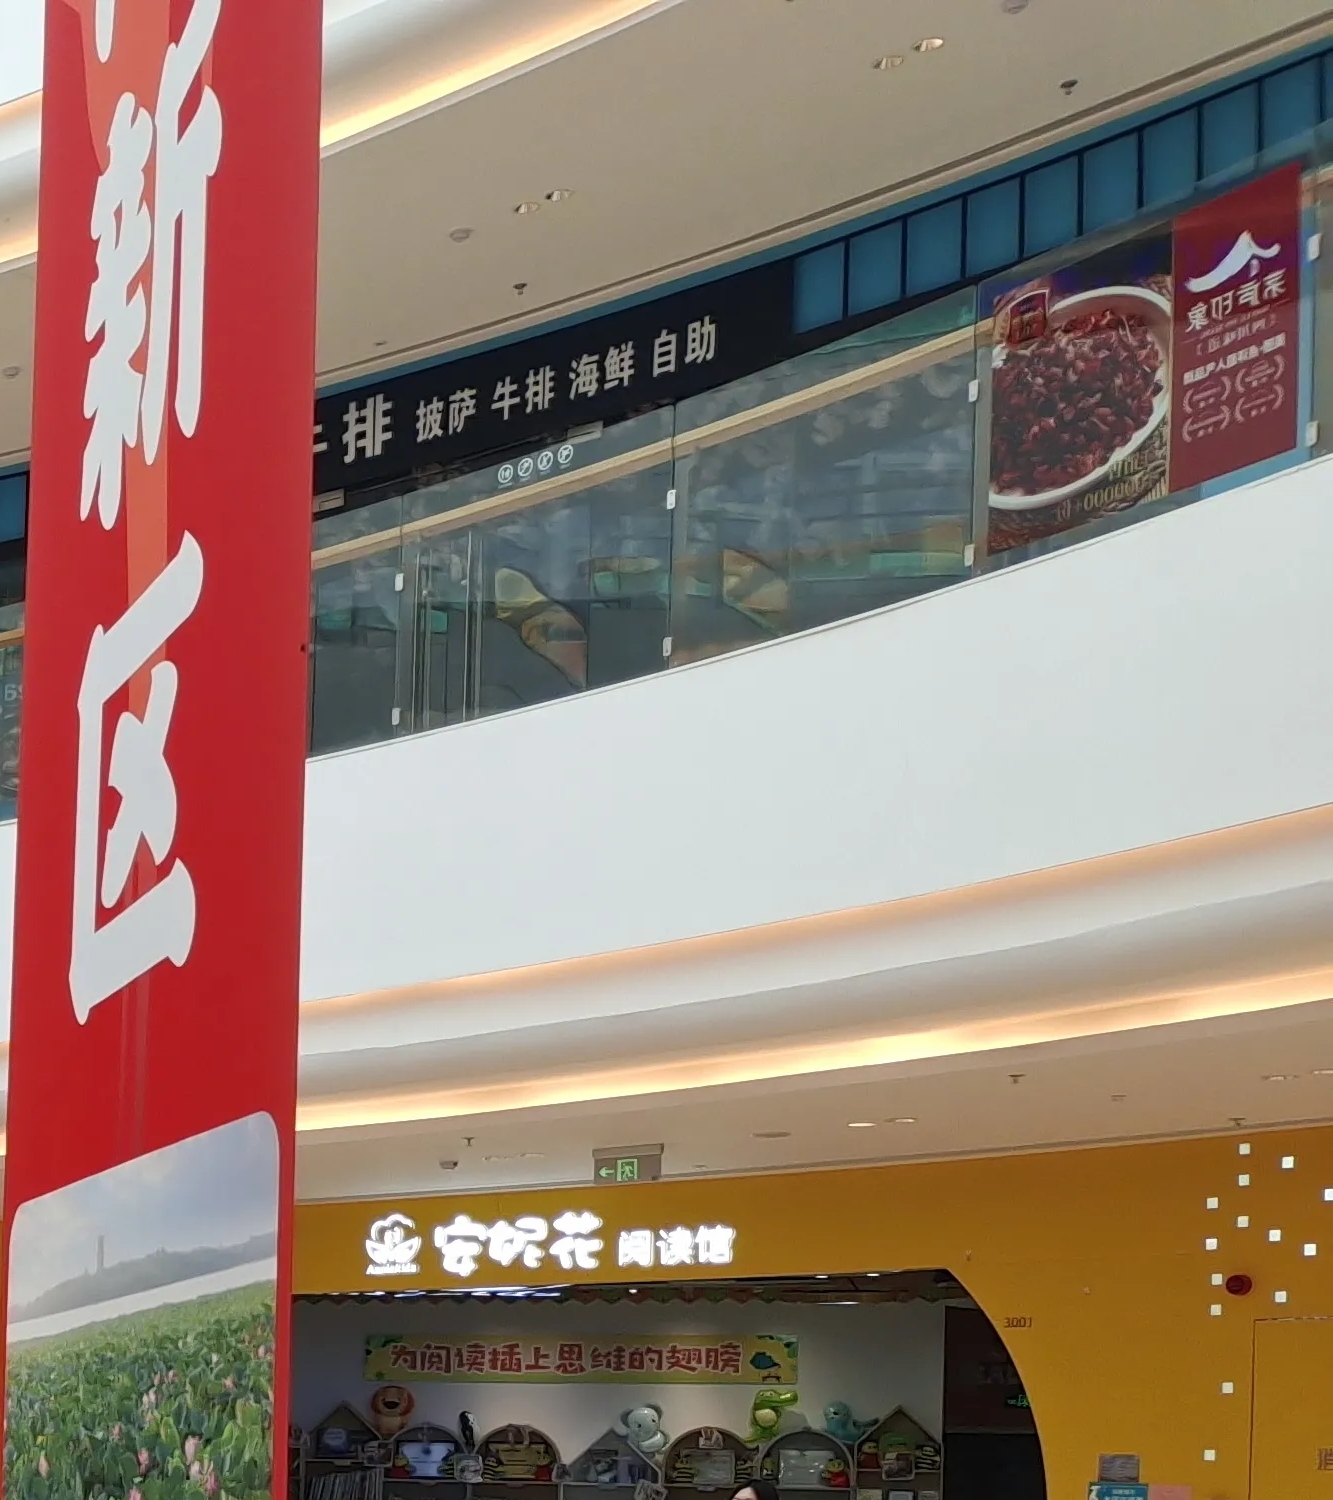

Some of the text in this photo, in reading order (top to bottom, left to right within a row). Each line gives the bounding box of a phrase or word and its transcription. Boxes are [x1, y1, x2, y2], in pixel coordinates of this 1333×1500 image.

[416, 388, 477, 443] 披萨
[491, 366, 554, 420] 牛排
[570, 341, 635, 400] 海鲜
[652, 315, 717, 378] 自助
[70, 0, 223, 1024] 新区
[617, 1225, 736, 1266] 阅读馆
[390, 1341, 743, 1374] 为阅读插上思维的翅膀
